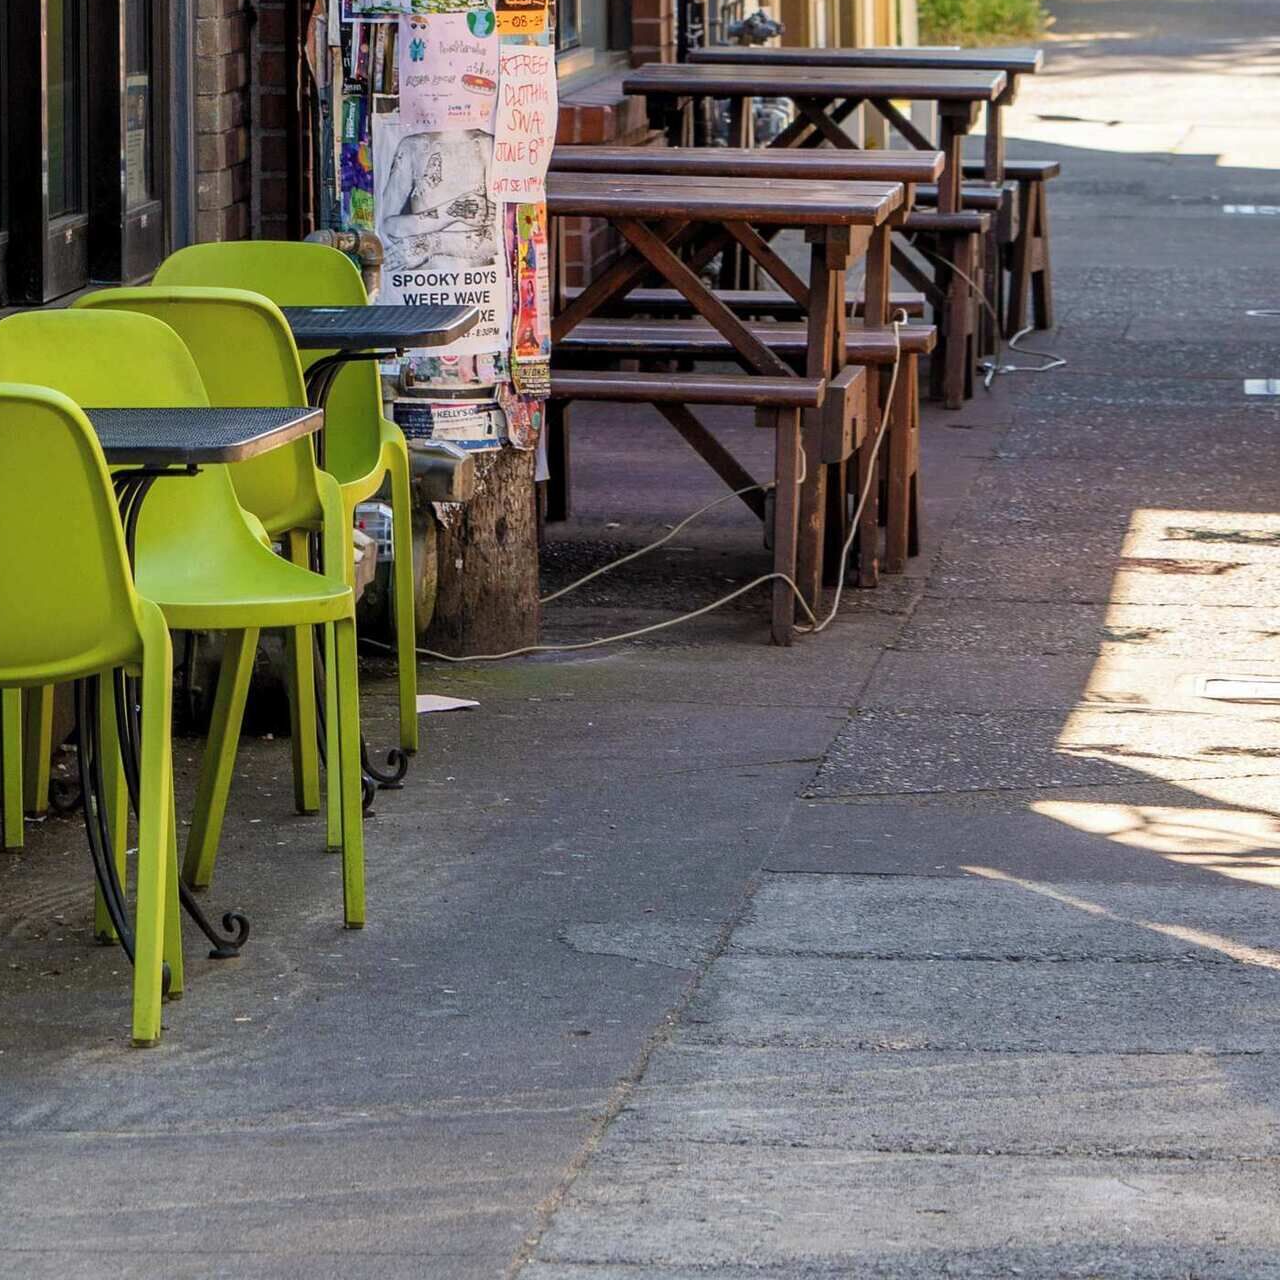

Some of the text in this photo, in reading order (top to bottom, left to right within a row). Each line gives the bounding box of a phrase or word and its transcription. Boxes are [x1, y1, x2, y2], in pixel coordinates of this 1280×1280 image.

[392, 270, 497, 288] SPOOKY BOYS
[403, 290, 490, 306] WEEP WAVE
[437, 409, 468, 418] KELLY'S
